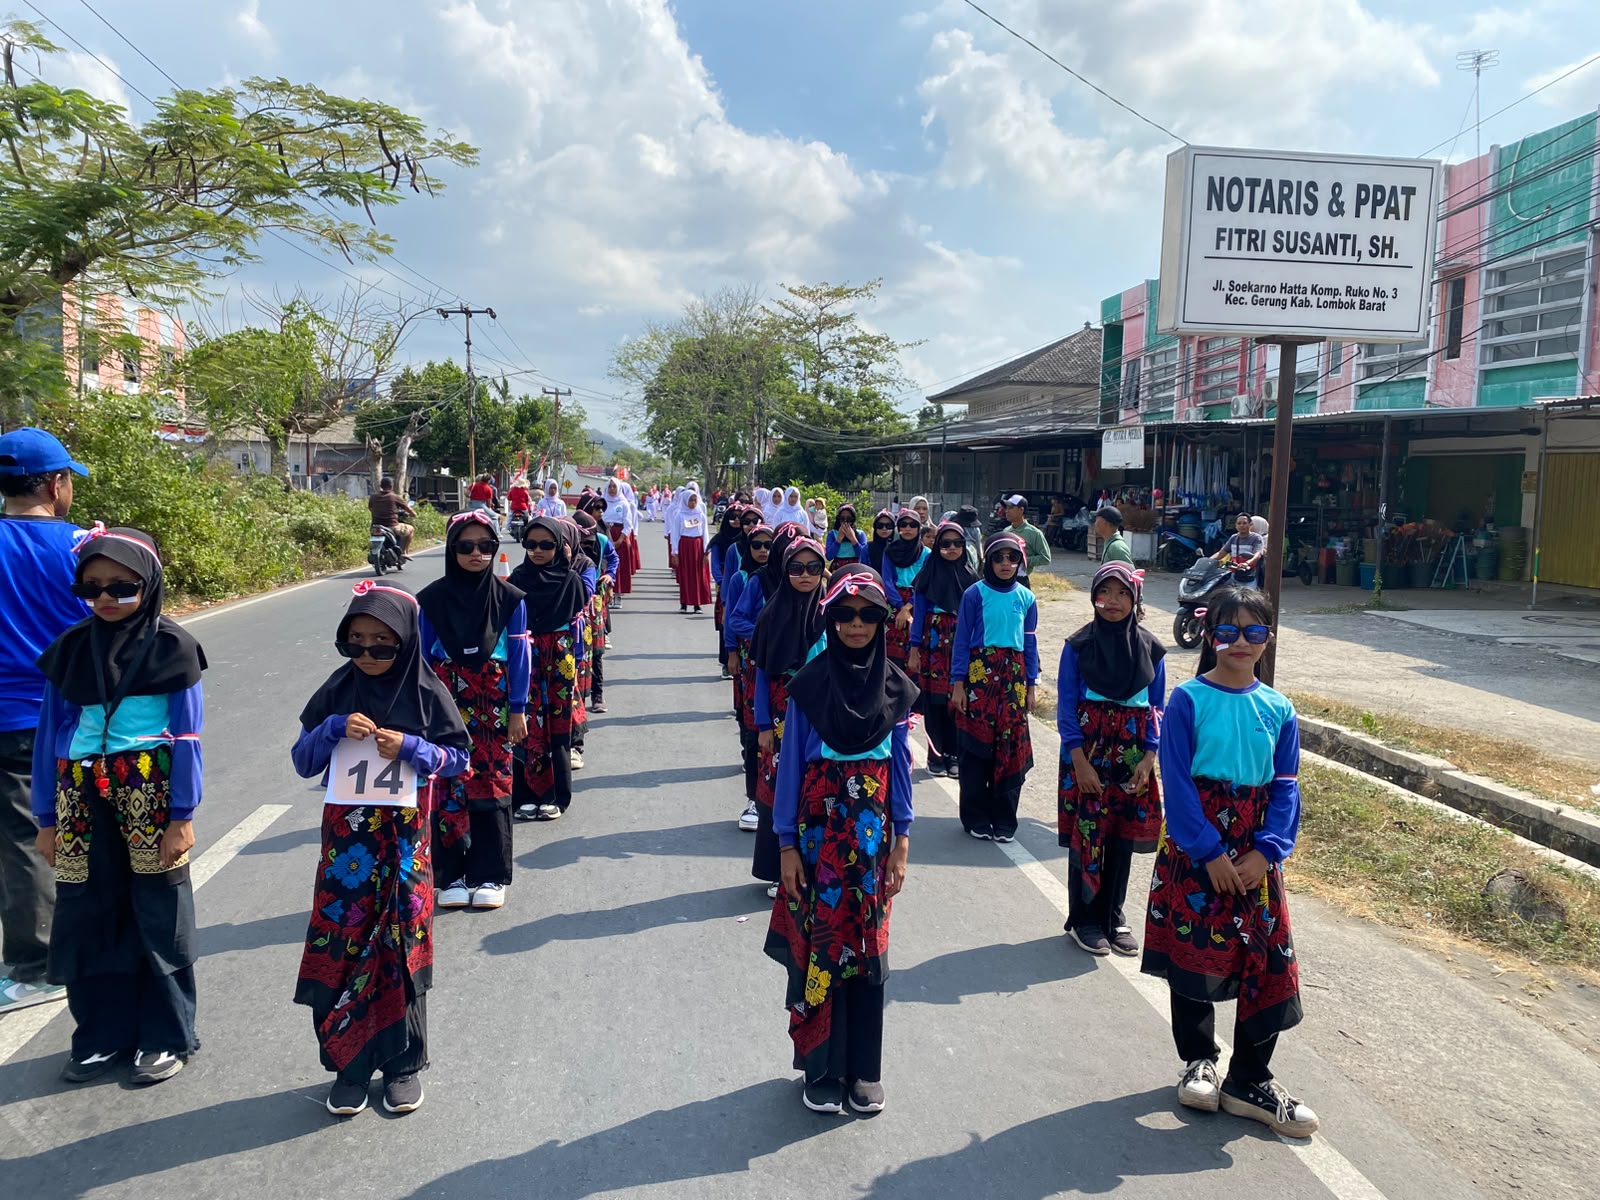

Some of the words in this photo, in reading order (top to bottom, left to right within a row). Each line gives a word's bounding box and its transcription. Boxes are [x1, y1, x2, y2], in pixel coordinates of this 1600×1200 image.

[1206, 176, 1319, 216] NOTARIS
[1328, 181, 1345, 218] &
[1355, 183, 1417, 221] PPAT
[1215, 227, 1266, 252] FITRI
[1272, 230, 1362, 262] SUSANTI,
[1368, 235, 1399, 259] SH.
[1212, 279, 1224, 292] Jl.
[1228, 280, 1277, 293] Soekarno
[1280, 283, 1308, 295] Hatta
[1311, 284, 1342, 298] Komp.
[1345, 286, 1370, 298] Ruko
[1372, 287, 1389, 299] No.
[1392, 288, 1398, 299] 3
[1225, 293, 1248, 305] Kec.
[1251, 294, 1287, 310] Gerung
[1290, 296, 1313, 308] Kab.
[1316, 297, 1356, 310] Lombok
[1359, 299, 1386, 312] Barat
[347, 760, 403, 794] 14
